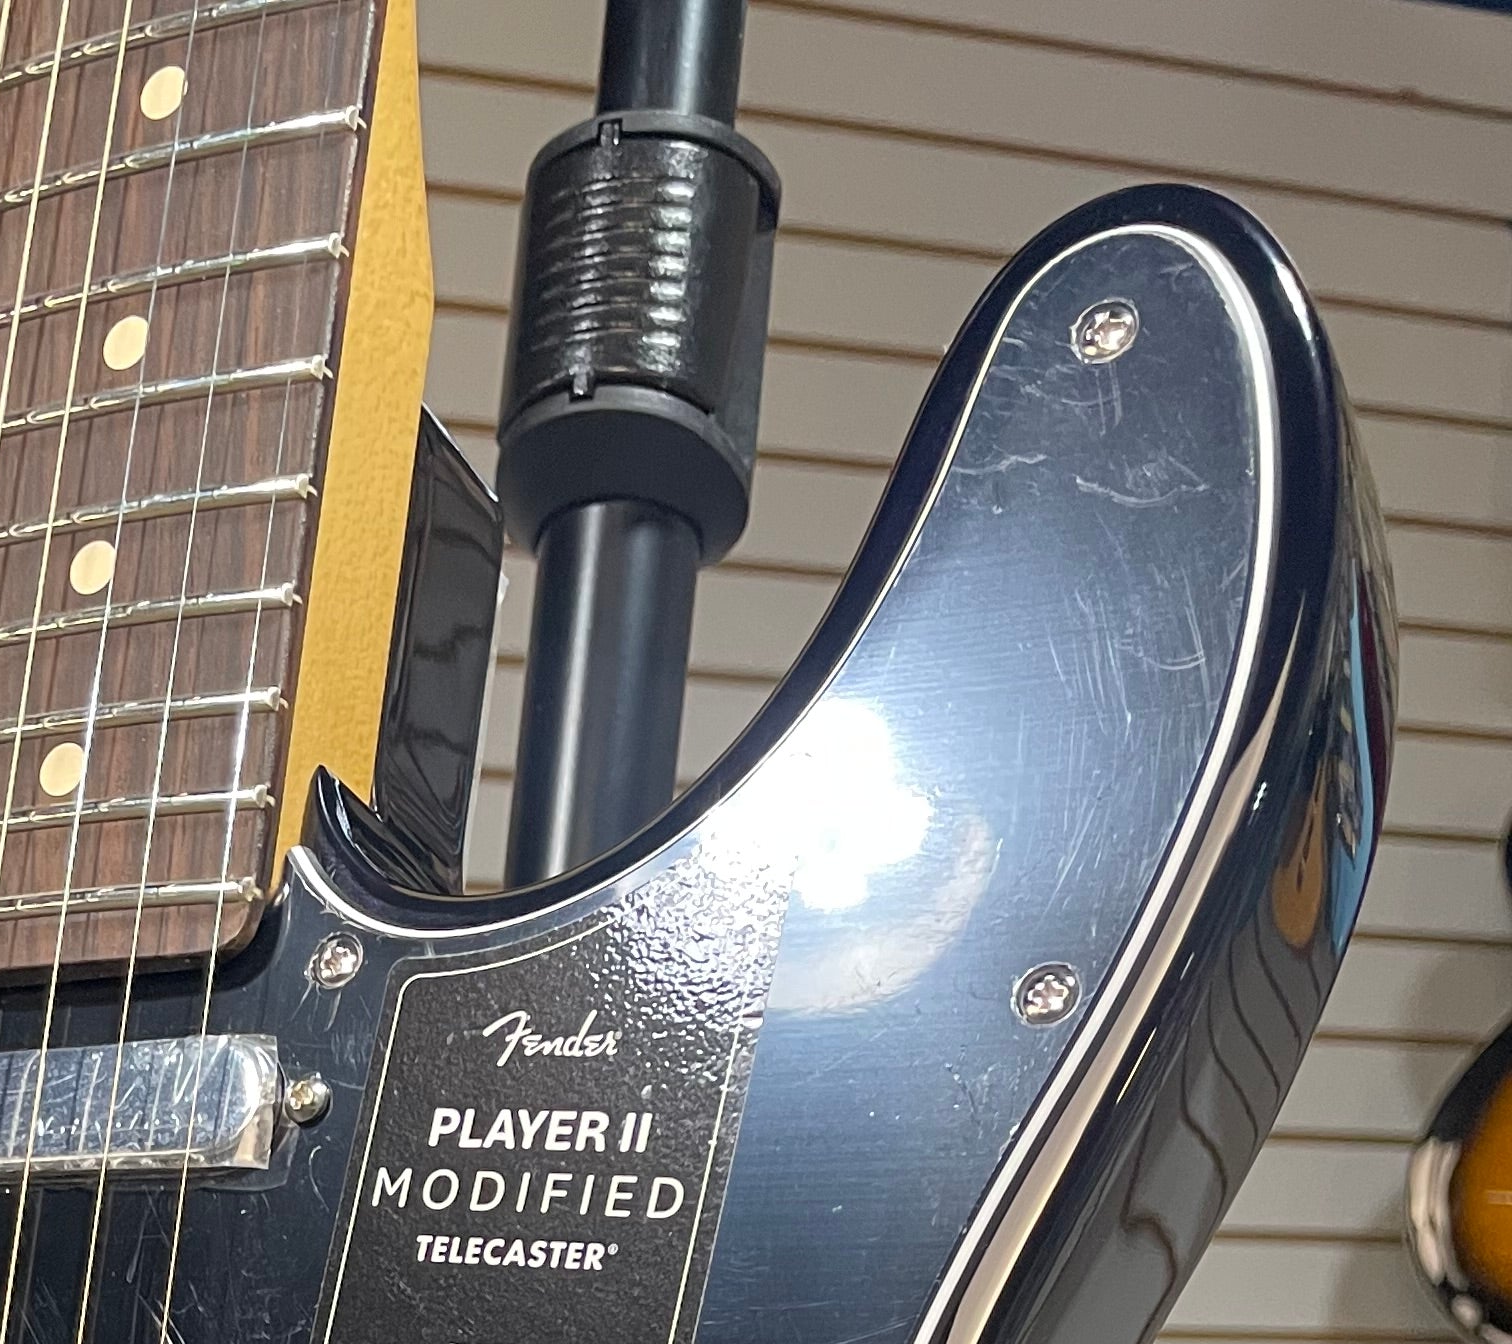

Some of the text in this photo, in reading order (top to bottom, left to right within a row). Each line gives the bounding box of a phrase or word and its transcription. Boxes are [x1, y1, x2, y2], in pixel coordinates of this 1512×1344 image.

[427, 1107, 653, 1153] PLAYER II
[371, 1166, 685, 1219] MODIFIED
